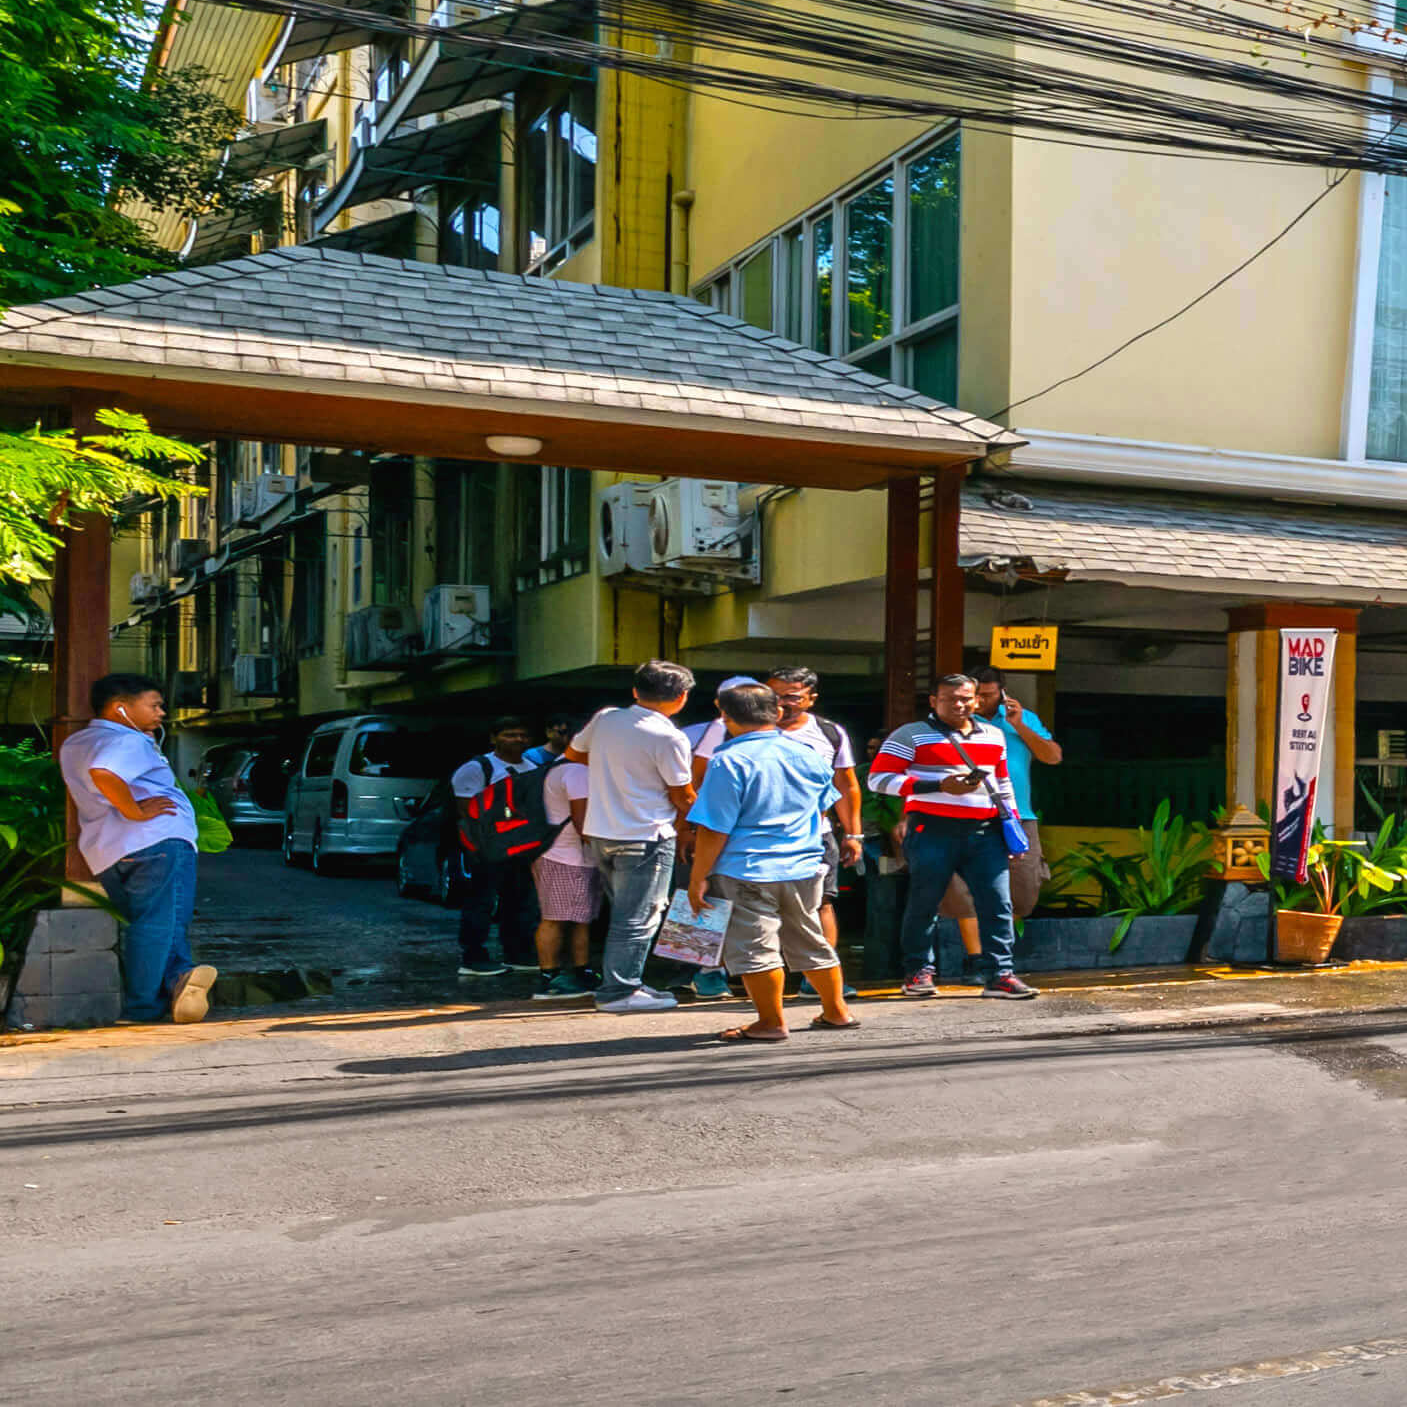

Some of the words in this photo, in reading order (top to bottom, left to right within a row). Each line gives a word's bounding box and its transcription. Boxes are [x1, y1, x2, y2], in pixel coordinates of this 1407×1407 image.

[1000, 634, 1049, 649] ทางเข้า
[1288, 638, 1325, 658] MAD
[1288, 657, 1325, 676] BIKE
